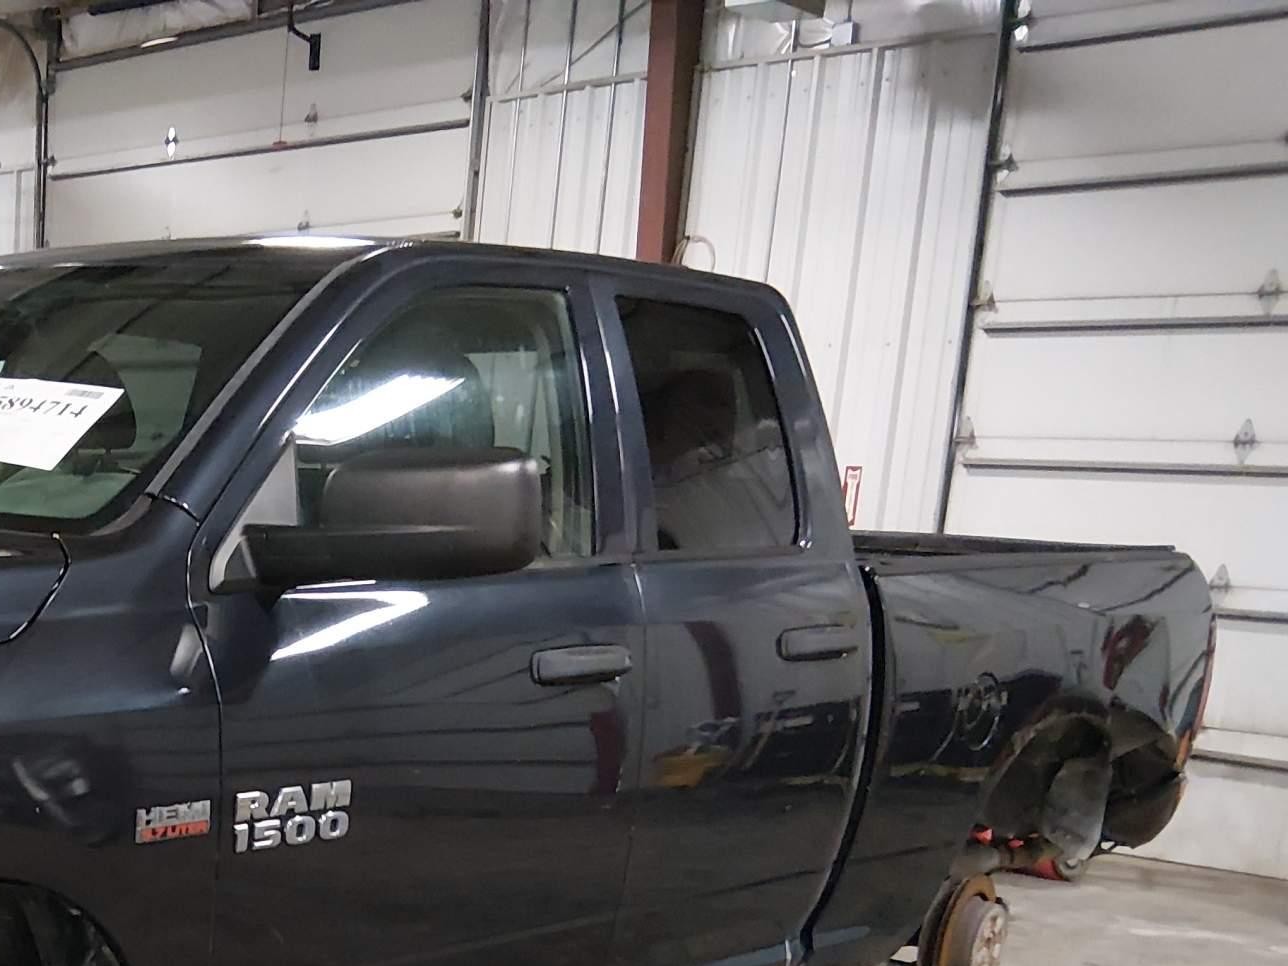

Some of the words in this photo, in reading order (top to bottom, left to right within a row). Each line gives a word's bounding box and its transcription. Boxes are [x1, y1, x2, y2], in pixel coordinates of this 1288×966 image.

[136, 800, 210, 829] HEMI
[235, 780, 352, 823] RAM
[233, 810, 349, 853] 1500
